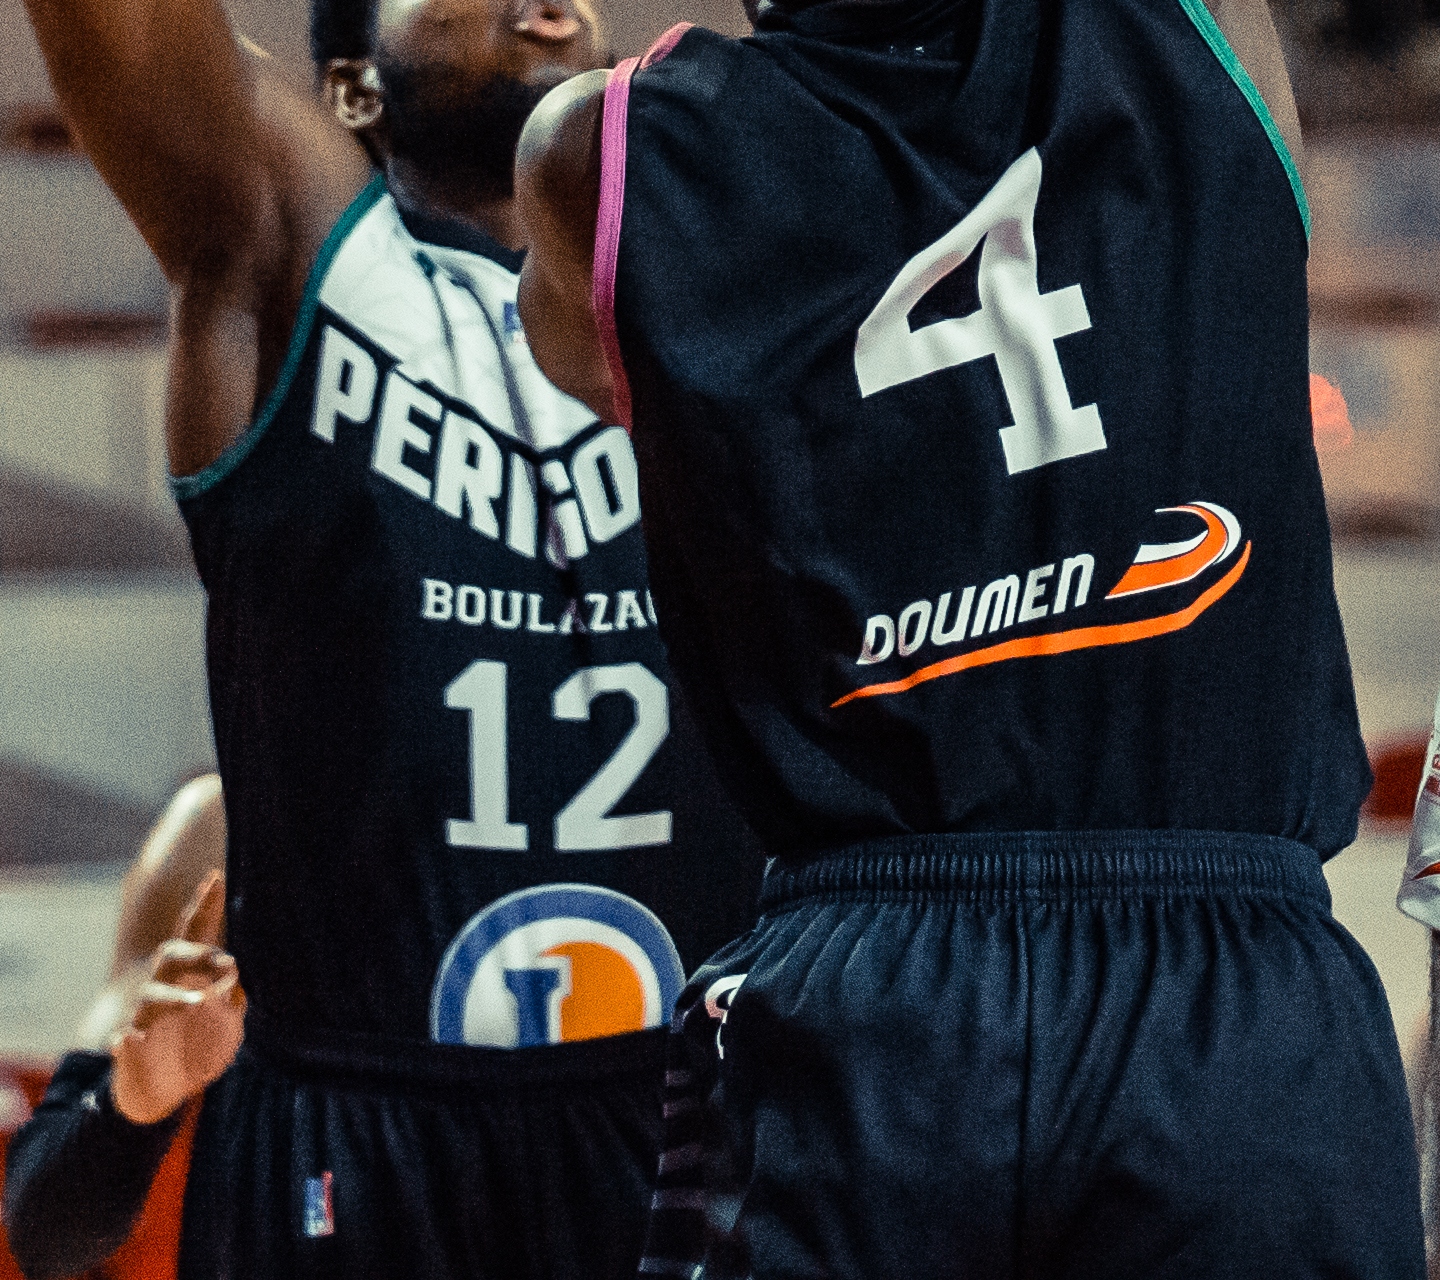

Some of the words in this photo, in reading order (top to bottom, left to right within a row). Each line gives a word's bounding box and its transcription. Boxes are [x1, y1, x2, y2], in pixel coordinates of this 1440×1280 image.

[855, 146, 1107, 475] 4
[856, 553, 1095, 665] DOUMEN
[444, 659, 673, 852] 12
